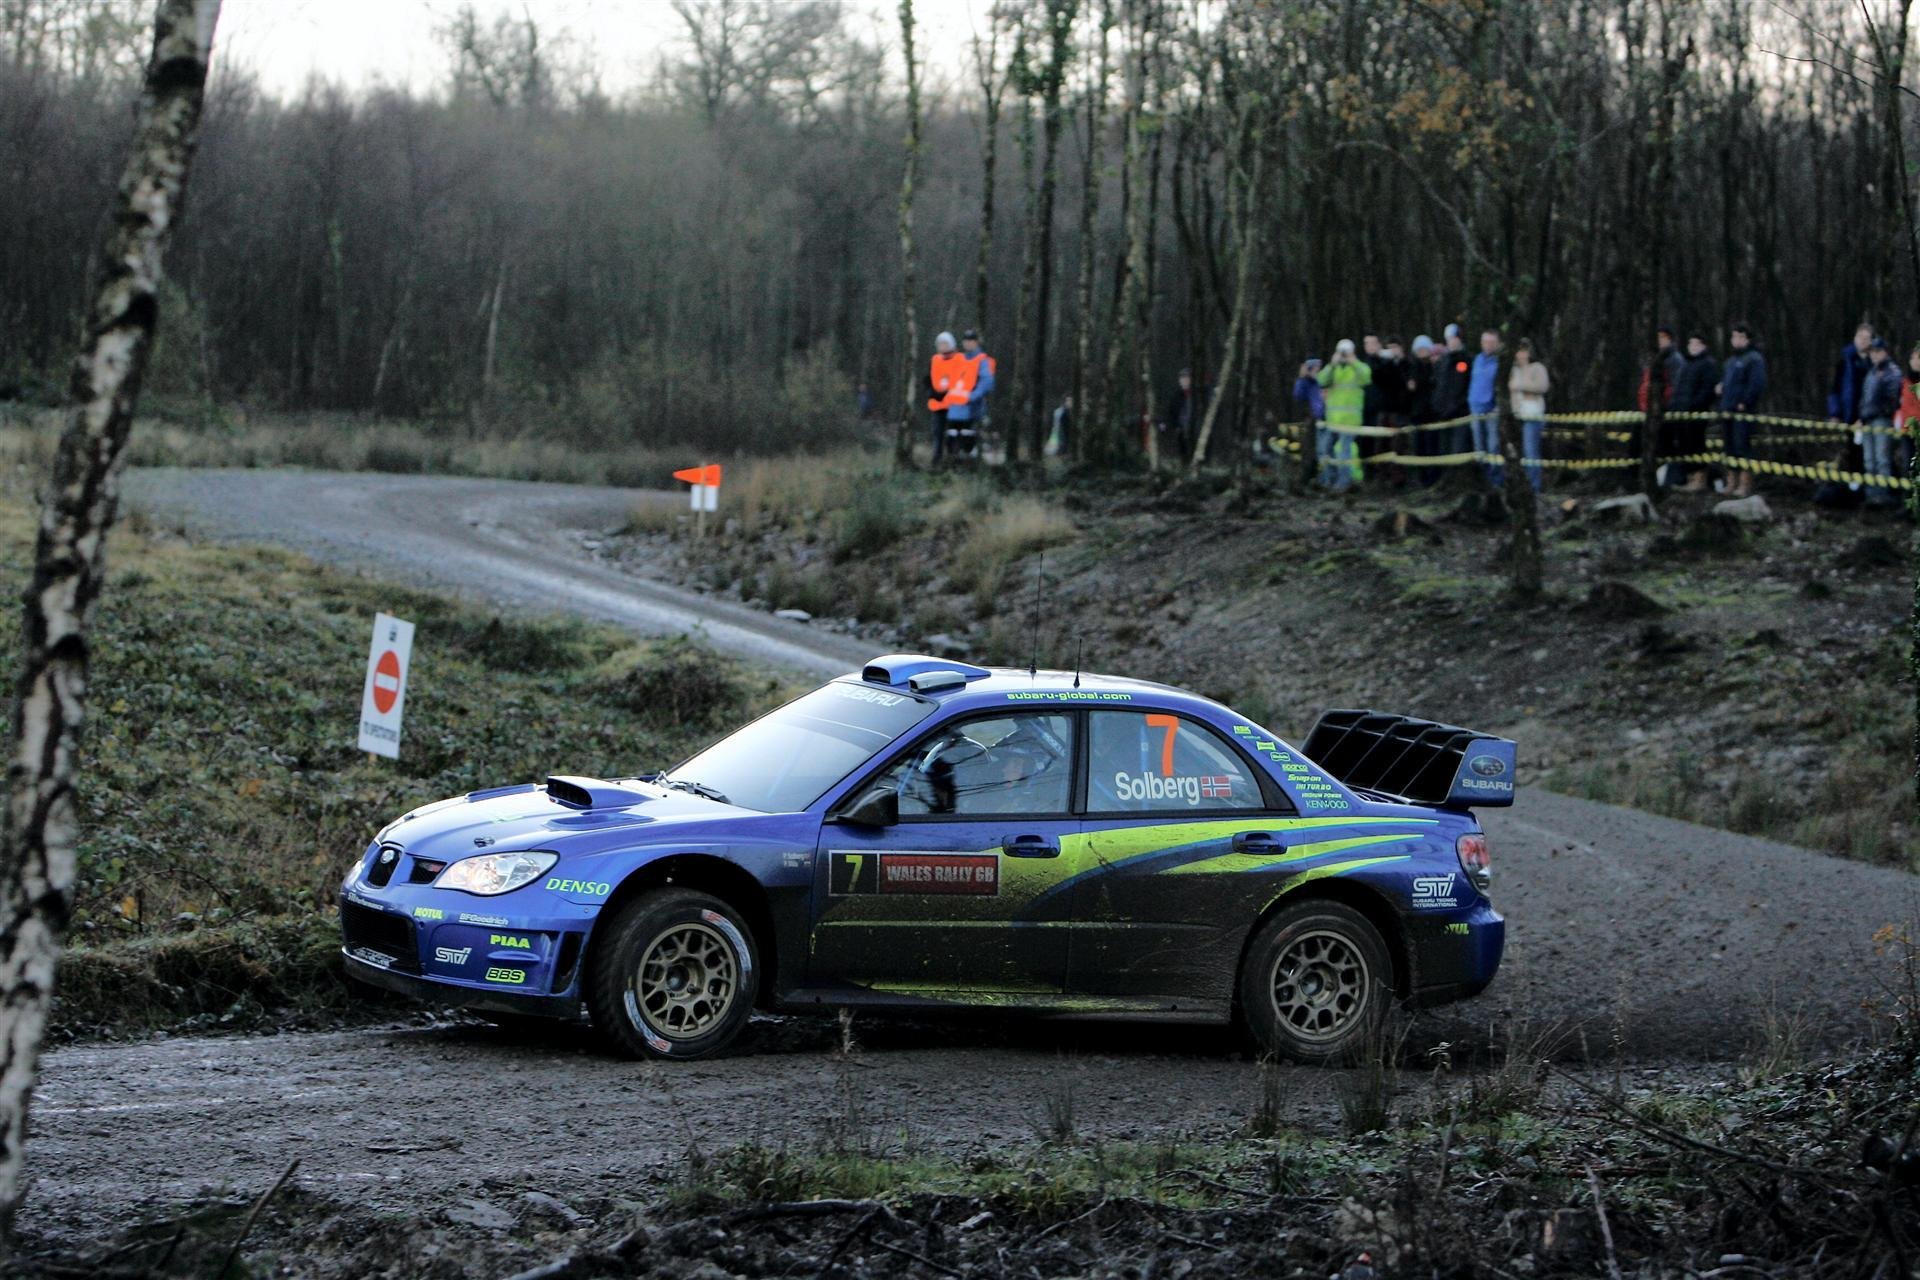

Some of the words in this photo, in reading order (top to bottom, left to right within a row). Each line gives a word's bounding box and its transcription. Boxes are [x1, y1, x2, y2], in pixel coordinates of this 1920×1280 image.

[1007, 692, 1132, 701] subaru-global.com
[1147, 714, 1179, 776] 7
[1115, 771, 1200, 806] Solberg
[1462, 778, 1513, 791] SUBARU
[1305, 800, 1349, 809] KENWOOD
[845, 854, 863, 893] 7
[886, 865, 933, 881] WALES
[935, 866, 972, 882] RALLY
[975, 866, 994, 882] GB
[545, 878, 611, 897] DENSO
[414, 906, 444, 920] MOTUL
[459, 912, 509, 926] BFGoodrich
[490, 934, 530, 949] PIAA
[487, 967, 524, 983] BBS
